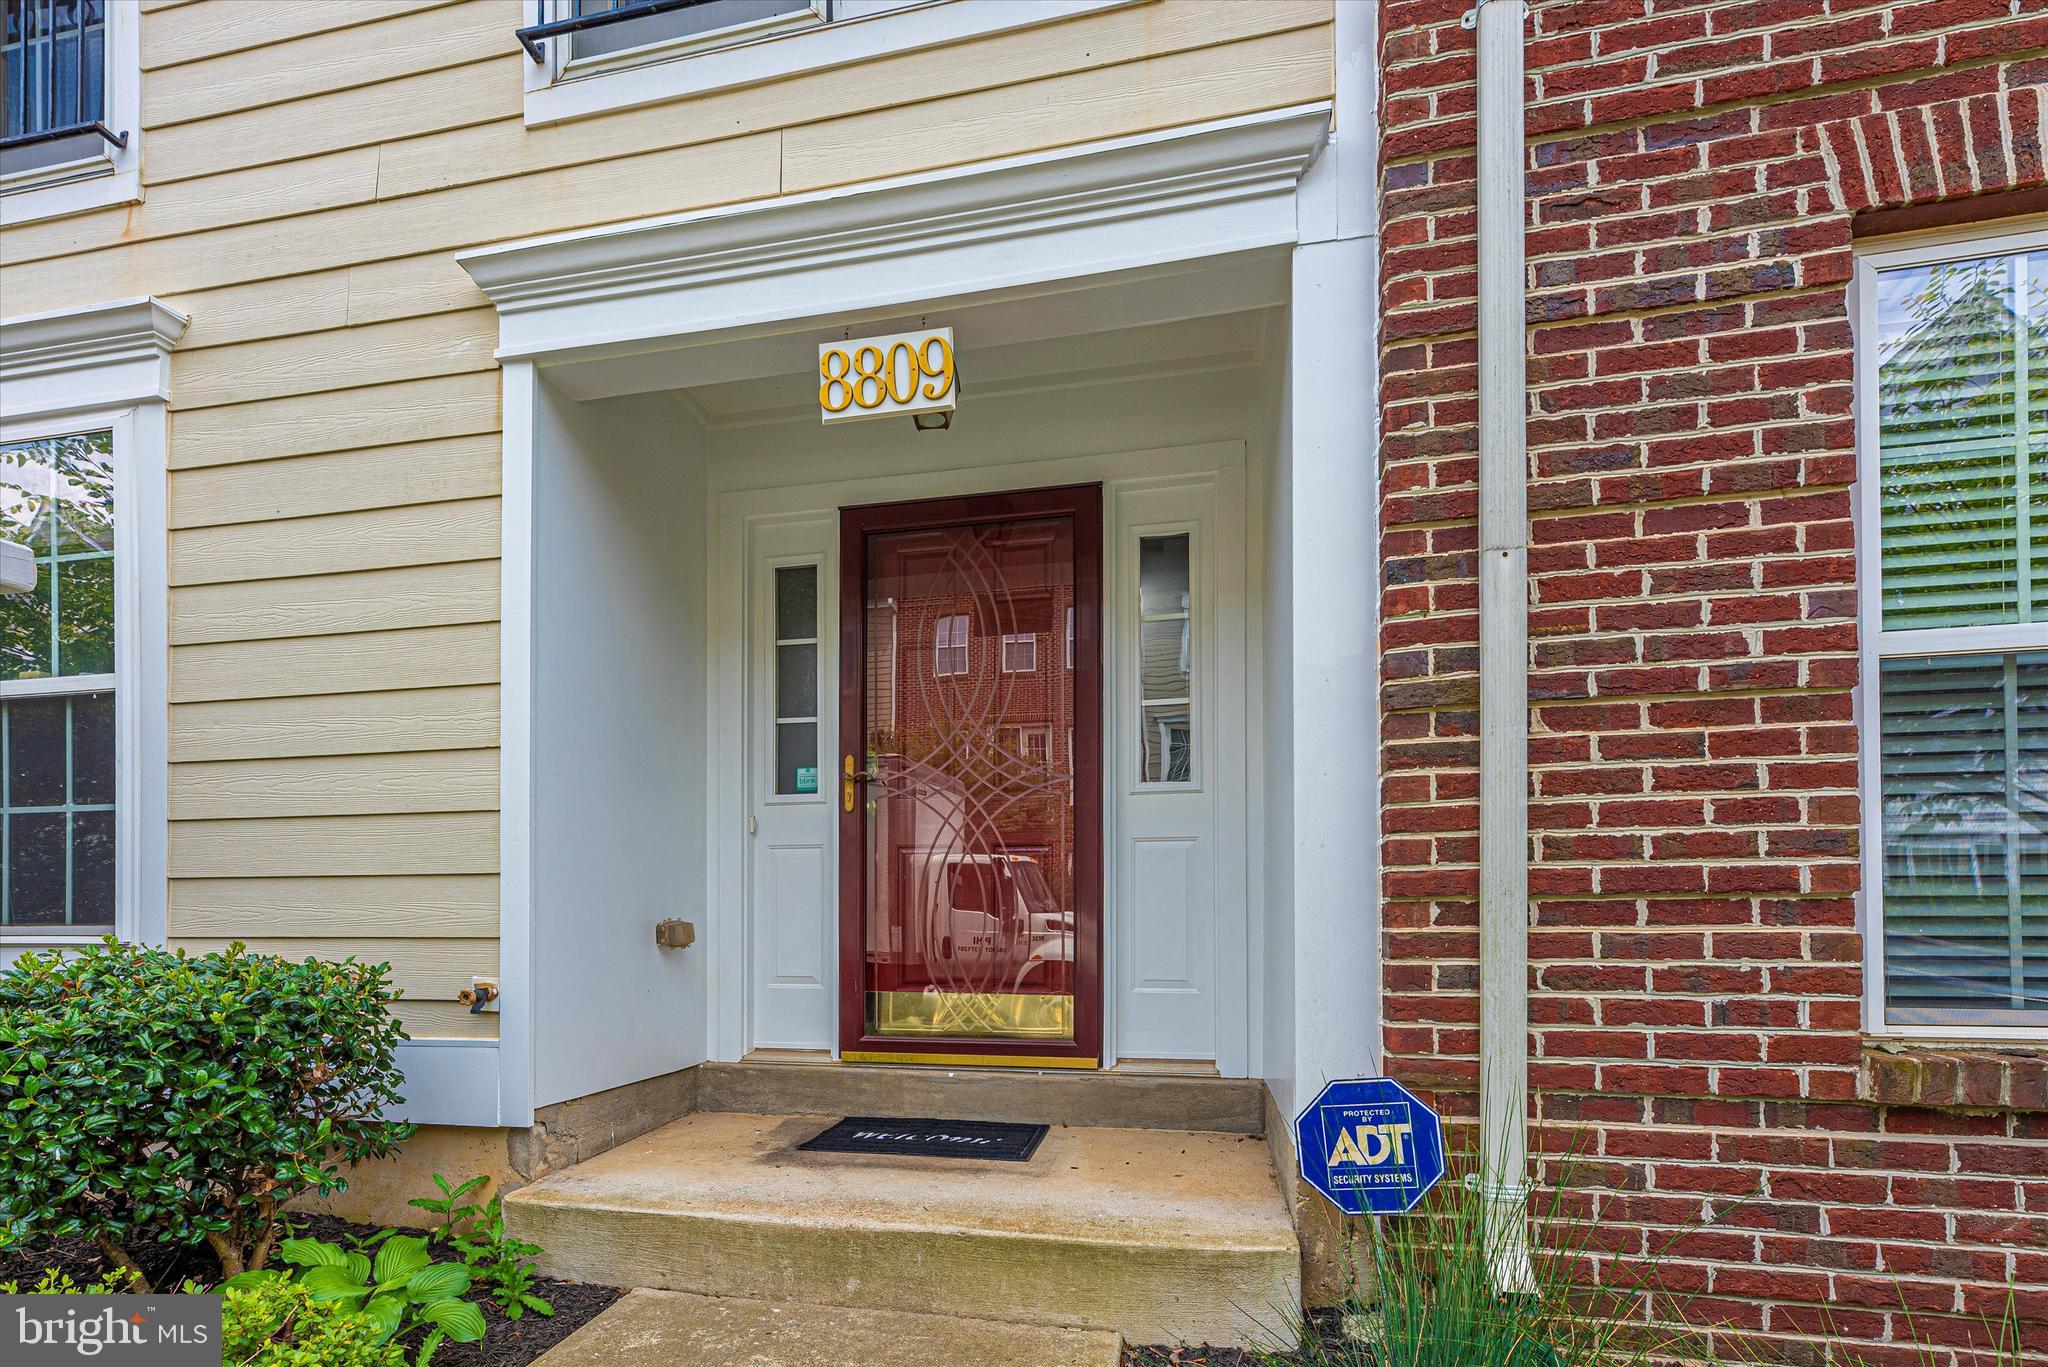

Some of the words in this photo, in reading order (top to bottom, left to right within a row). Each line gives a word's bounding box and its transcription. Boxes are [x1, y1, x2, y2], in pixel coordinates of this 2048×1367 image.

[819, 335, 955, 412] 8809
[1343, 1109, 1390, 1117] PROTECTED
[1328, 1123, 1411, 1167] ADT
[1333, 1174, 1372, 1185] SECURITY
[1374, 1173, 1413, 1184] SYSTEMS
